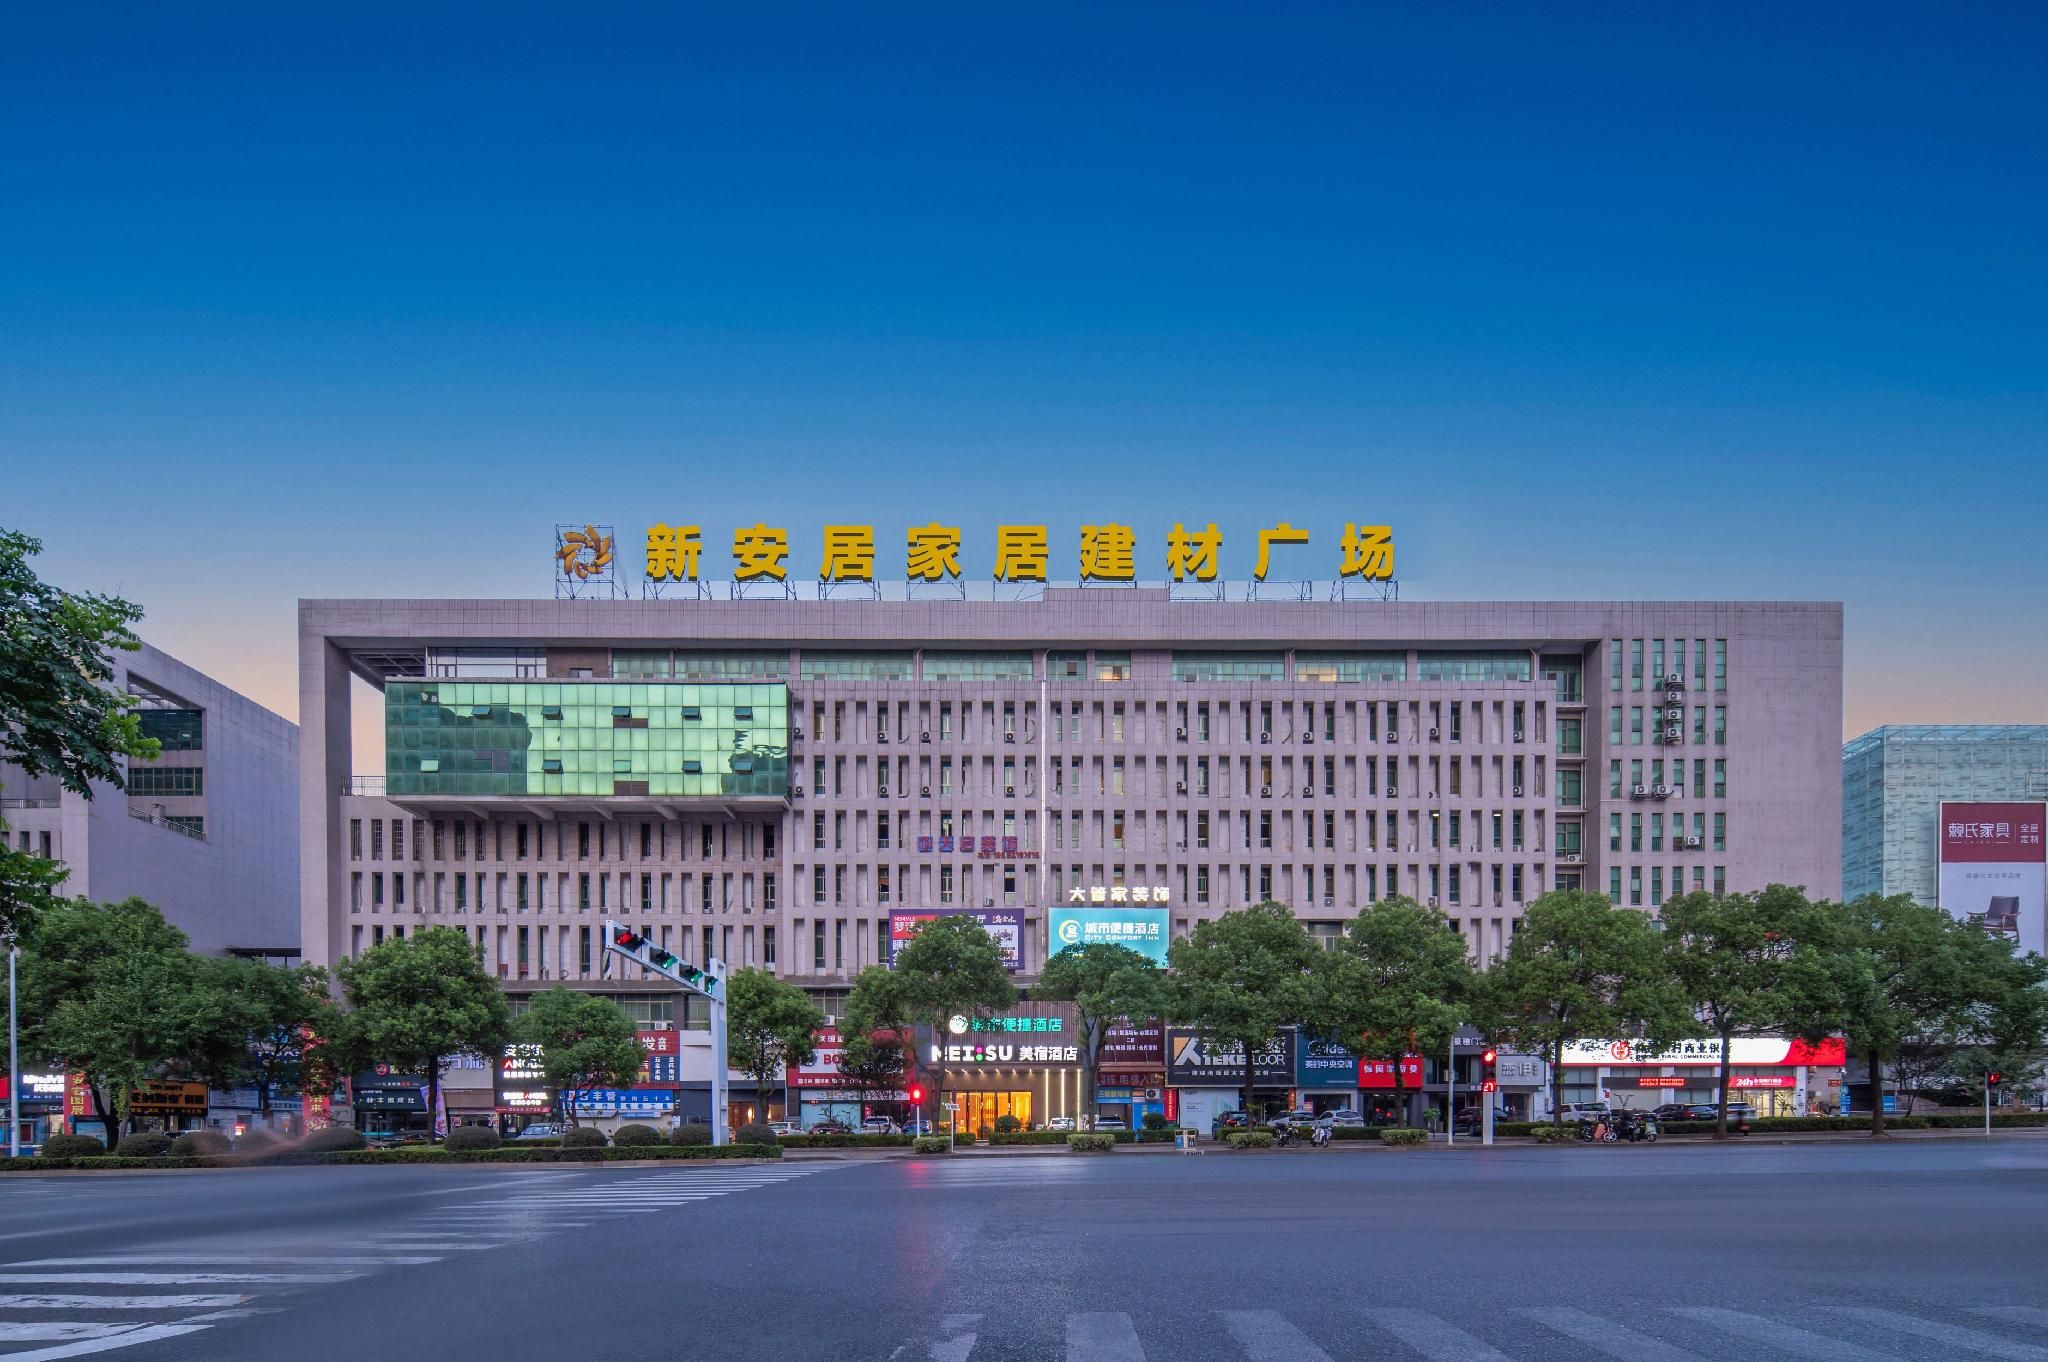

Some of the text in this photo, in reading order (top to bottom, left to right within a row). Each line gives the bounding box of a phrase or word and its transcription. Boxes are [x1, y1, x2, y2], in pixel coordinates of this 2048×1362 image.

[646, 523, 1396, 582] 新安居家居建材广场
[1069, 886, 1170, 902] 大管家装饰
[1085, 922, 1159, 935] 城市便捷酒店
[1019, 1046, 1078, 1061] 美宿酒店
[1252, 1055, 1285, 1065] LOOR
[1483, 1082, 1494, 1091] 27
[1735, 1078, 1754, 1087] 24h
